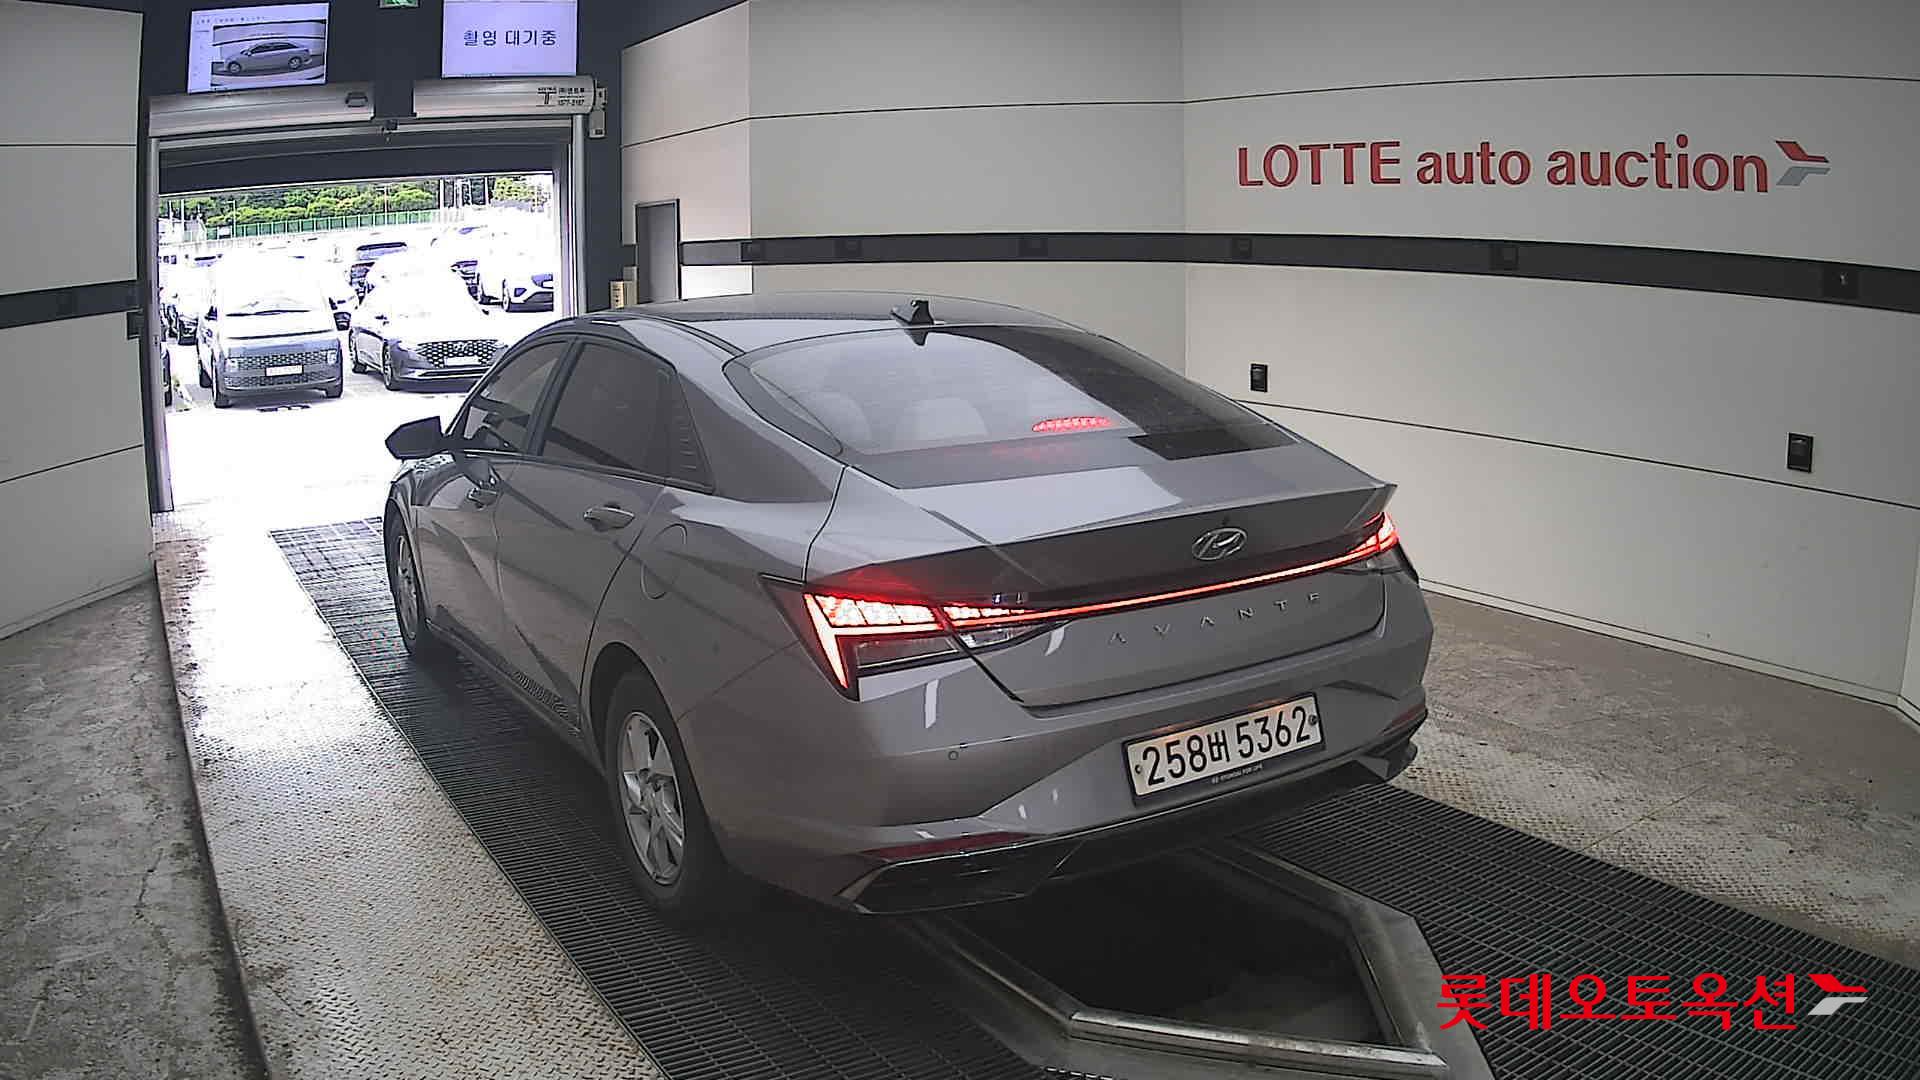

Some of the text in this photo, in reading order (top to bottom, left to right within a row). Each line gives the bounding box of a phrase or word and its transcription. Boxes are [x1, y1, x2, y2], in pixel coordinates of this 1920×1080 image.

[505, 29, 556, 46] 대기중
[1238, 134, 1769, 193] LOTTE auto auction
[1109, 592, 1320, 644] AVANTE
[1142, 729, 1231, 787] 258버
[1235, 705, 1311, 759] 5362
